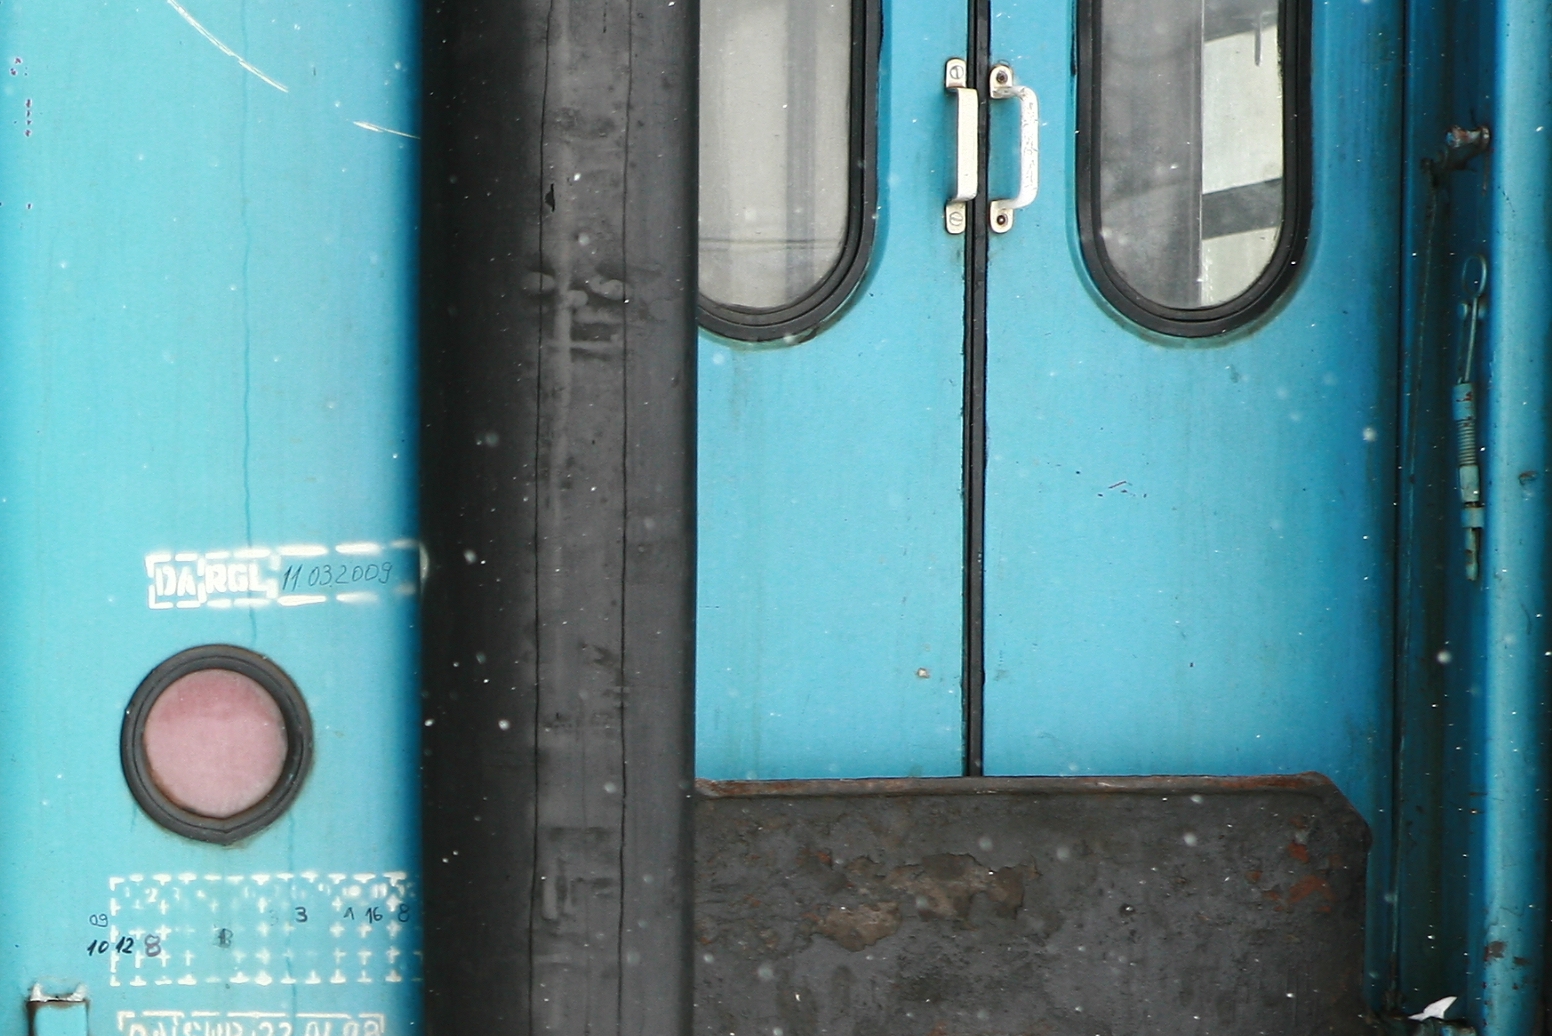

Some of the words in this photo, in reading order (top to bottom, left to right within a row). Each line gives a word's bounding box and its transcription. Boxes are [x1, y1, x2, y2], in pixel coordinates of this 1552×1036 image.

[155, 565, 196, 596] DA
[205, 563, 267, 593] RGL
[295, 906, 309, 923] 3
[365, 906, 383, 924] 16
[398, 903, 410, 923] 8
[87, 939, 109, 956] 10
[115, 936, 134, 954] 12
[144, 933, 161, 957] 8
